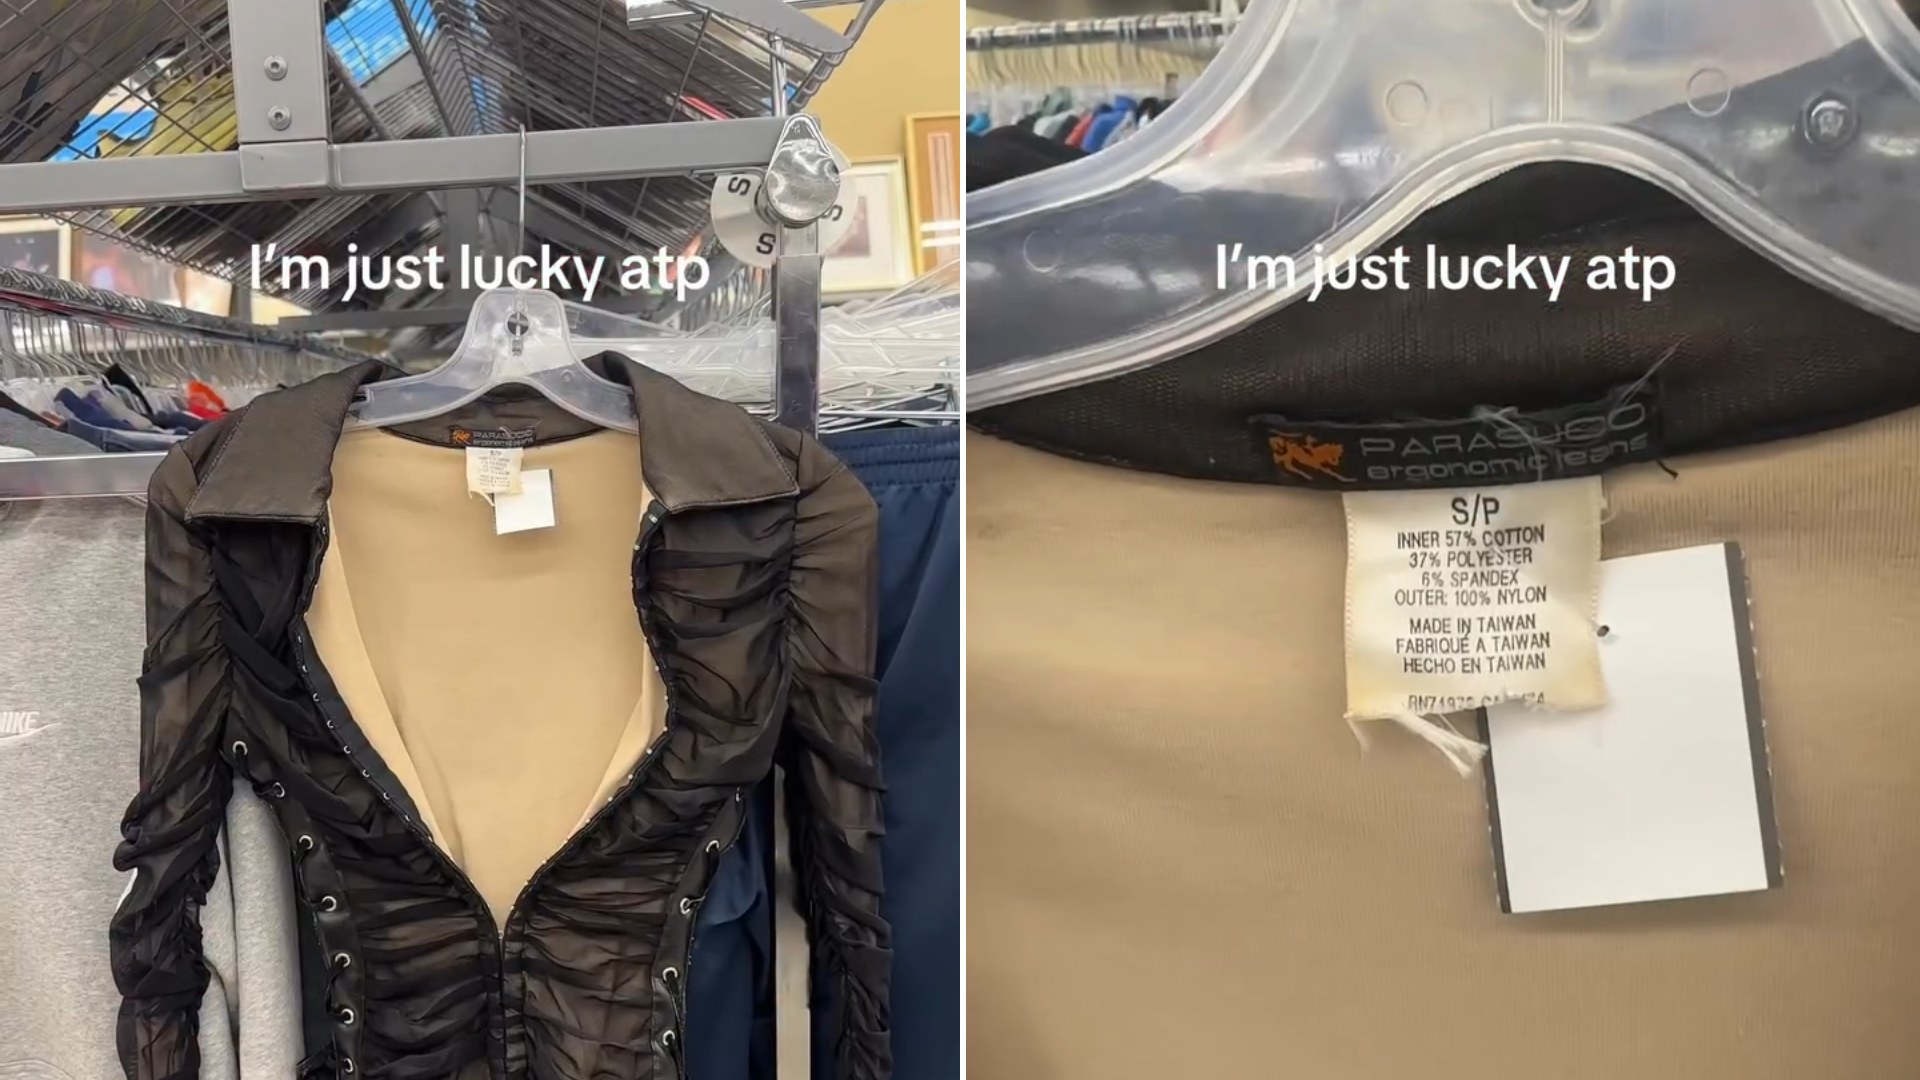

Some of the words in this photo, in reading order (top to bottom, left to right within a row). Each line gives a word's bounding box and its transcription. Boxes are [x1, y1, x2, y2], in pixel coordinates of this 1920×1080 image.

[728, 176, 751, 196] S
[756, 233, 777, 255] S
[1366, 454, 1549, 482] ergonomic
[1451, 493, 1500, 528] S/P
[1397, 530, 1441, 550] INNER
[1445, 530, 1477, 549] 57%
[1482, 524, 1545, 549] COTTON
[1408, 550, 1441, 569] 37%
[1446, 546, 1533, 569] POLYESTER
[1421, 570, 1444, 588] 6%
[1449, 568, 1520, 588] SPANDEX
[1394, 588, 1449, 607] OUTER:
[1454, 588, 1492, 607] 100%
[1497, 584, 1547, 606] NYLON
[1409, 616, 1452, 635] MADE
[1457, 616, 1472, 635] IN
[1477, 612, 1536, 634] TAIWAN
[1476, 636, 1487, 654] A
[1491, 631, 1551, 653] TAIWAN
[1403, 657, 1456, 674] HECHO
[1461, 656, 1481, 673] EN
[1486, 651, 1546, 673] TAIWAN
